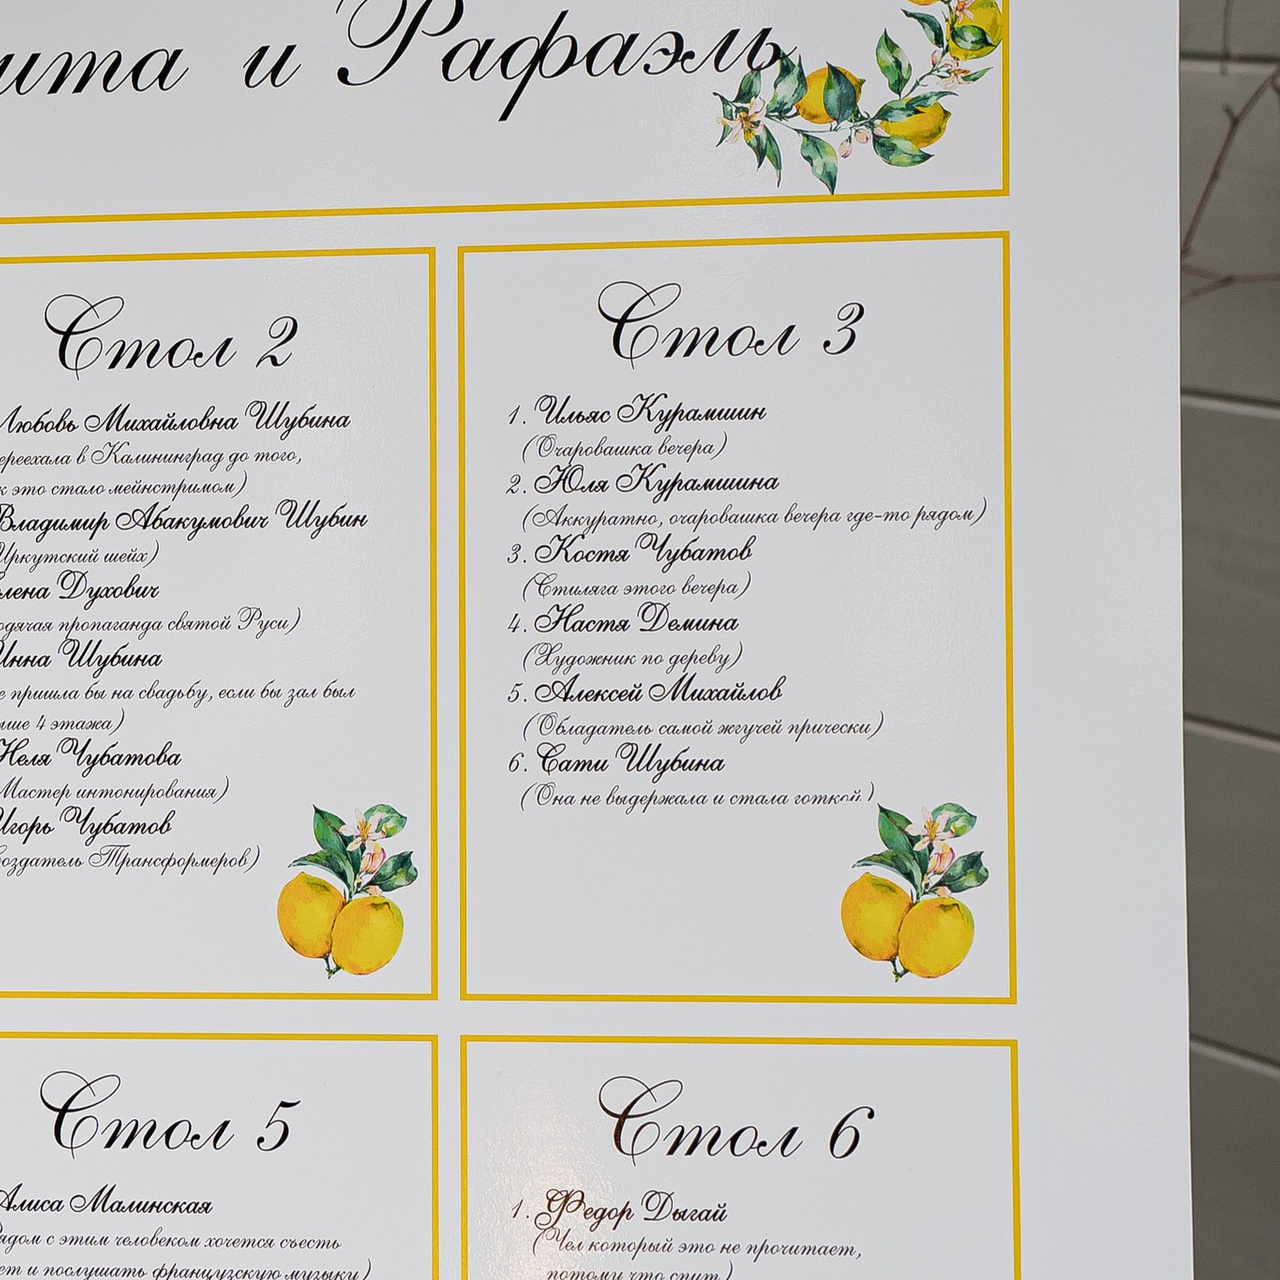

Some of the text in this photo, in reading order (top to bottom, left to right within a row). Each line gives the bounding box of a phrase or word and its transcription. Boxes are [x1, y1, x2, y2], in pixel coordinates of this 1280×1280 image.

[242, 43, 302, 89] и
[44, 293, 299, 382] Стол 2
[597, 280, 865, 371] Стол 3
[83, 402, 240, 433] Михайловна
[244, 399, 352, 442] Шубина
[508, 392, 768, 435] 1. Ильяс Курамшин
[76, 444, 89, 465] в
[90, 440, 225, 473] Калининград
[225, 451, 250, 473] до
[253, 451, 302, 465] того,
[11, 485, 48, 496] это
[50, 484, 107, 496] стало
[505, 460, 781, 505] 2. Юля Курамшина
[114, 501, 270, 542] Абакумович
[274, 498, 369, 540] Шубин
[668, 504, 780, 533] очаровашка
[783, 502, 842, 532] вечера
[846, 510, 912, 533] где-то
[507, 600, 740, 634] 4. Настя Демина
[507, 671, 787, 703] 5. Алексей Михайлов
[658, 719, 714, 736] самой
[717, 718, 783, 745] жгучей
[55, 736, 183, 779] Чубатова
[39, 1070, 302, 1160] Стол 5
[598, 1075, 875, 1167] Стол 6
[69, 1183, 214, 1215] Малинская
[46, 1234, 56, 1246] с
[58, 1235, 111, 1247] этим
[114, 1226, 202, 1248] человеком
[203, 1237, 276, 1249] хочется
[279, 1238, 343, 1250] съесть
[26, 1265, 40, 1277] и
